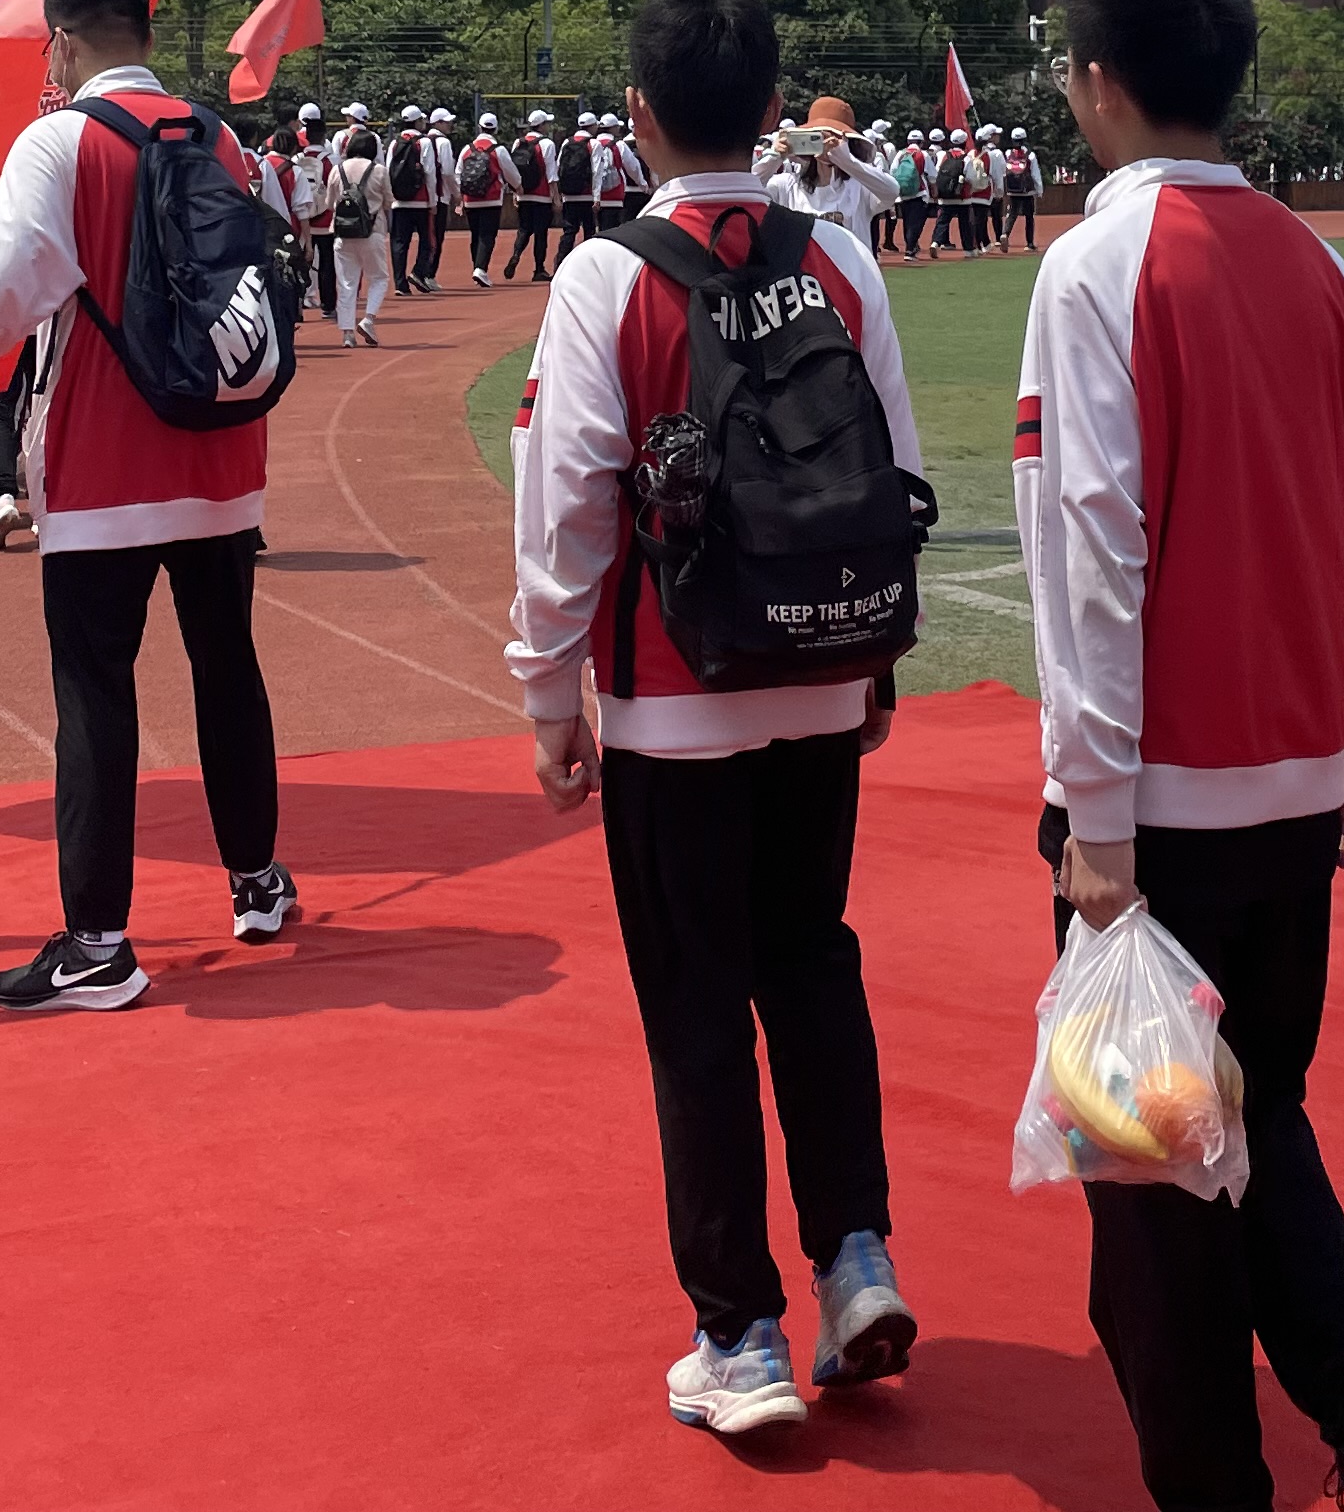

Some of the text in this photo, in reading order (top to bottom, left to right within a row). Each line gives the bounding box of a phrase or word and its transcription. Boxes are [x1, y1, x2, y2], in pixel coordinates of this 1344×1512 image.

[749, 274, 826, 340] BEAT
[767, 604, 814, 623] KEEP
[817, 601, 850, 621] THE
[854, 591, 881, 616] BEAT
[882, 582, 903, 603] UP
